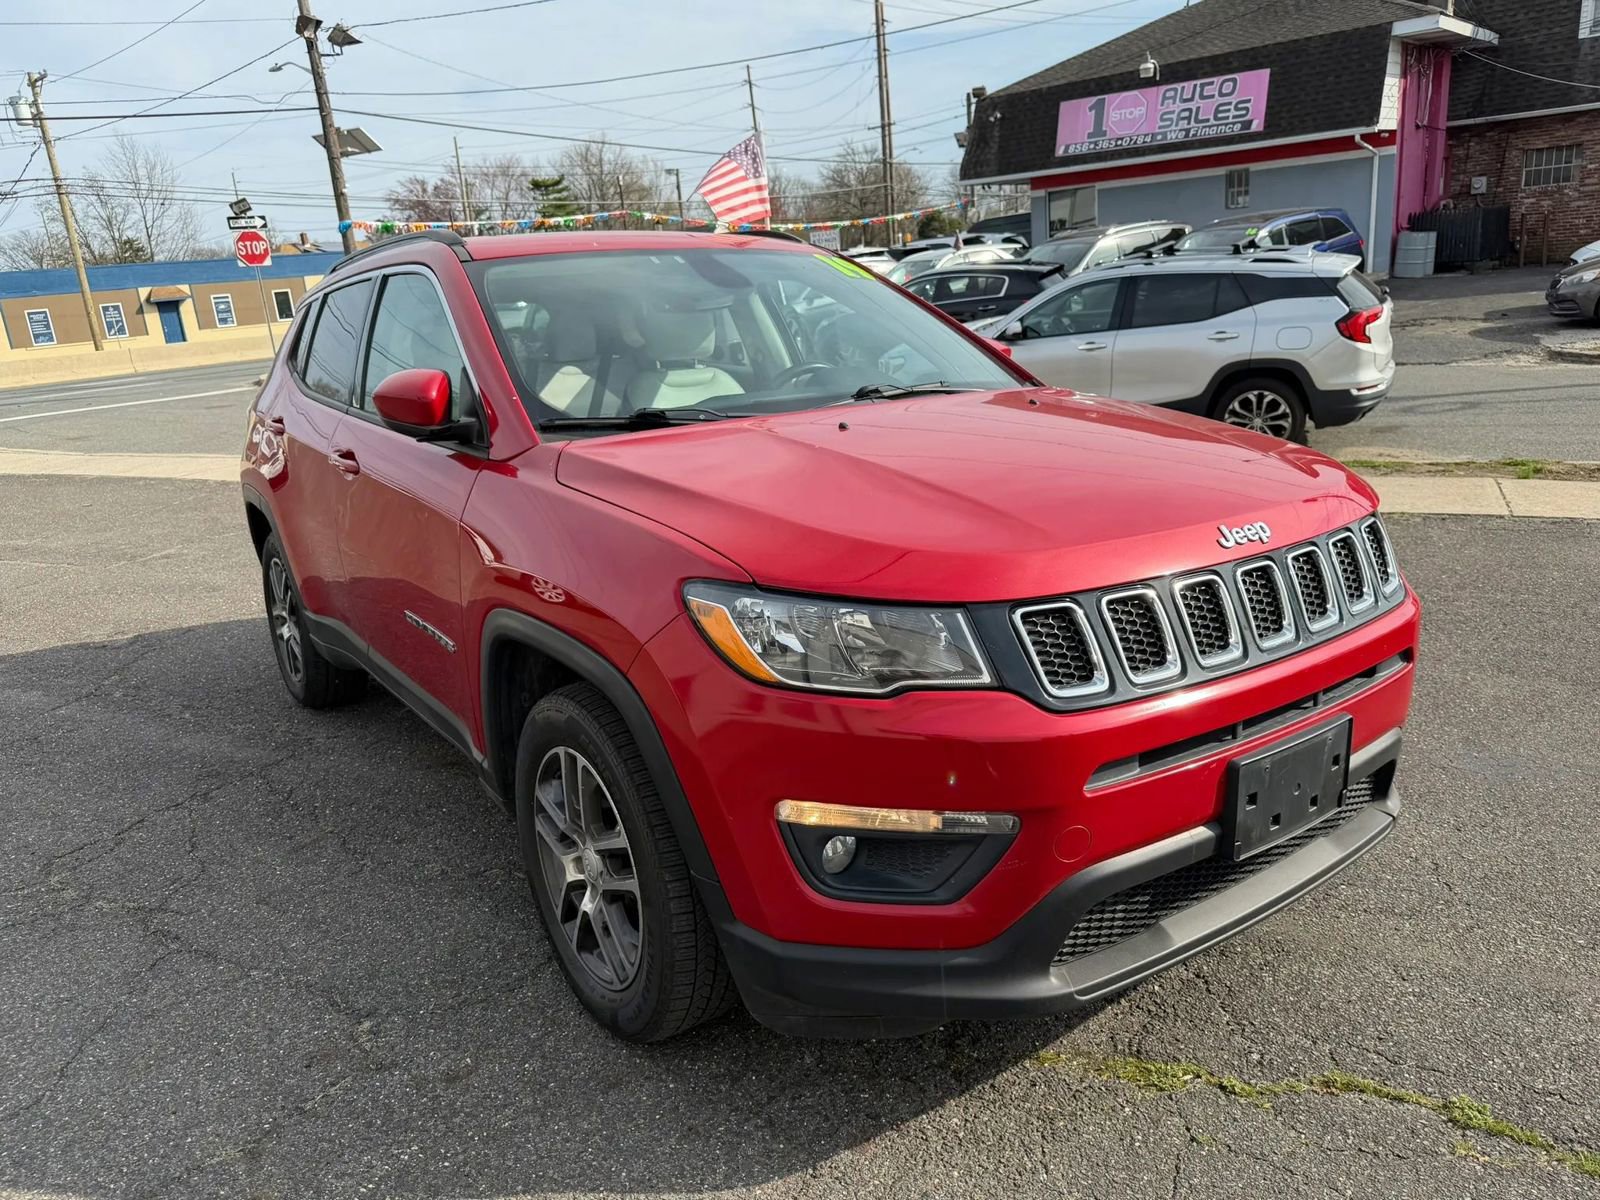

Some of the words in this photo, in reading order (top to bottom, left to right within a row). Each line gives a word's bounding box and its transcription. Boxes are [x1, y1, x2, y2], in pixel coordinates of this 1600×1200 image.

[1159, 76, 1238, 107] AUTO
[1087, 97, 1108, 140] 1
[1111, 106, 1145, 122] STOP
[1158, 98, 1252, 130] SALES
[1167, 128, 1185, 141] We
[1189, 122, 1241, 138] Finance
[238, 241, 267, 256] STOP
[1216, 521, 1271, 549] Jeep
